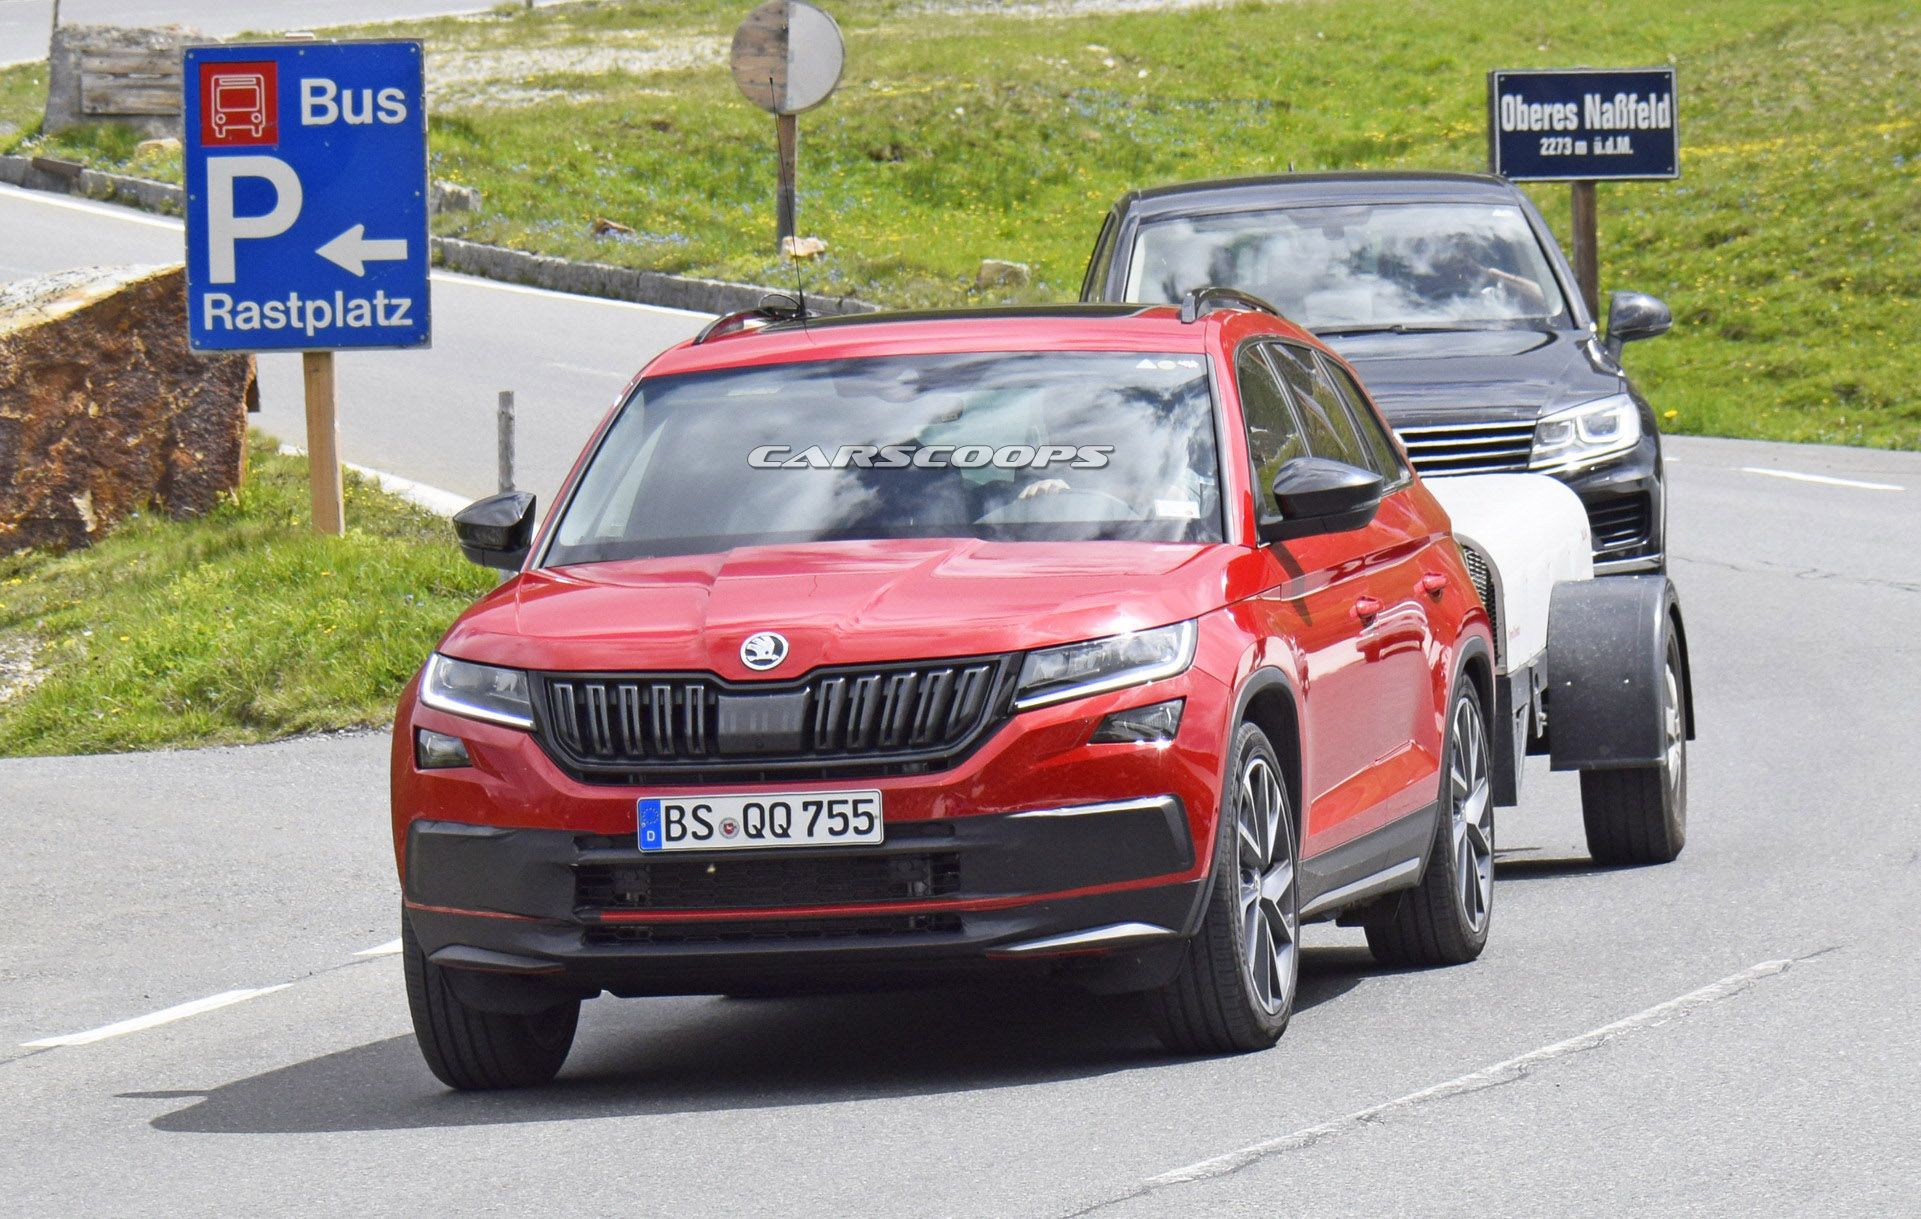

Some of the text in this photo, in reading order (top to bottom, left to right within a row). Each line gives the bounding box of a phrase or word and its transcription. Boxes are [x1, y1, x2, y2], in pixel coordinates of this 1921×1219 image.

[301, 78, 408, 126] Bus
[1501, 92, 1671, 132] Oberes Naßfeld
[1539, 136, 1573, 156] 2273
[1574, 140, 1588, 155] m
[206, 155, 303, 284] P
[203, 290, 413, 337] Rastplatz
[646, 798, 875, 843] D BS QQ 755
